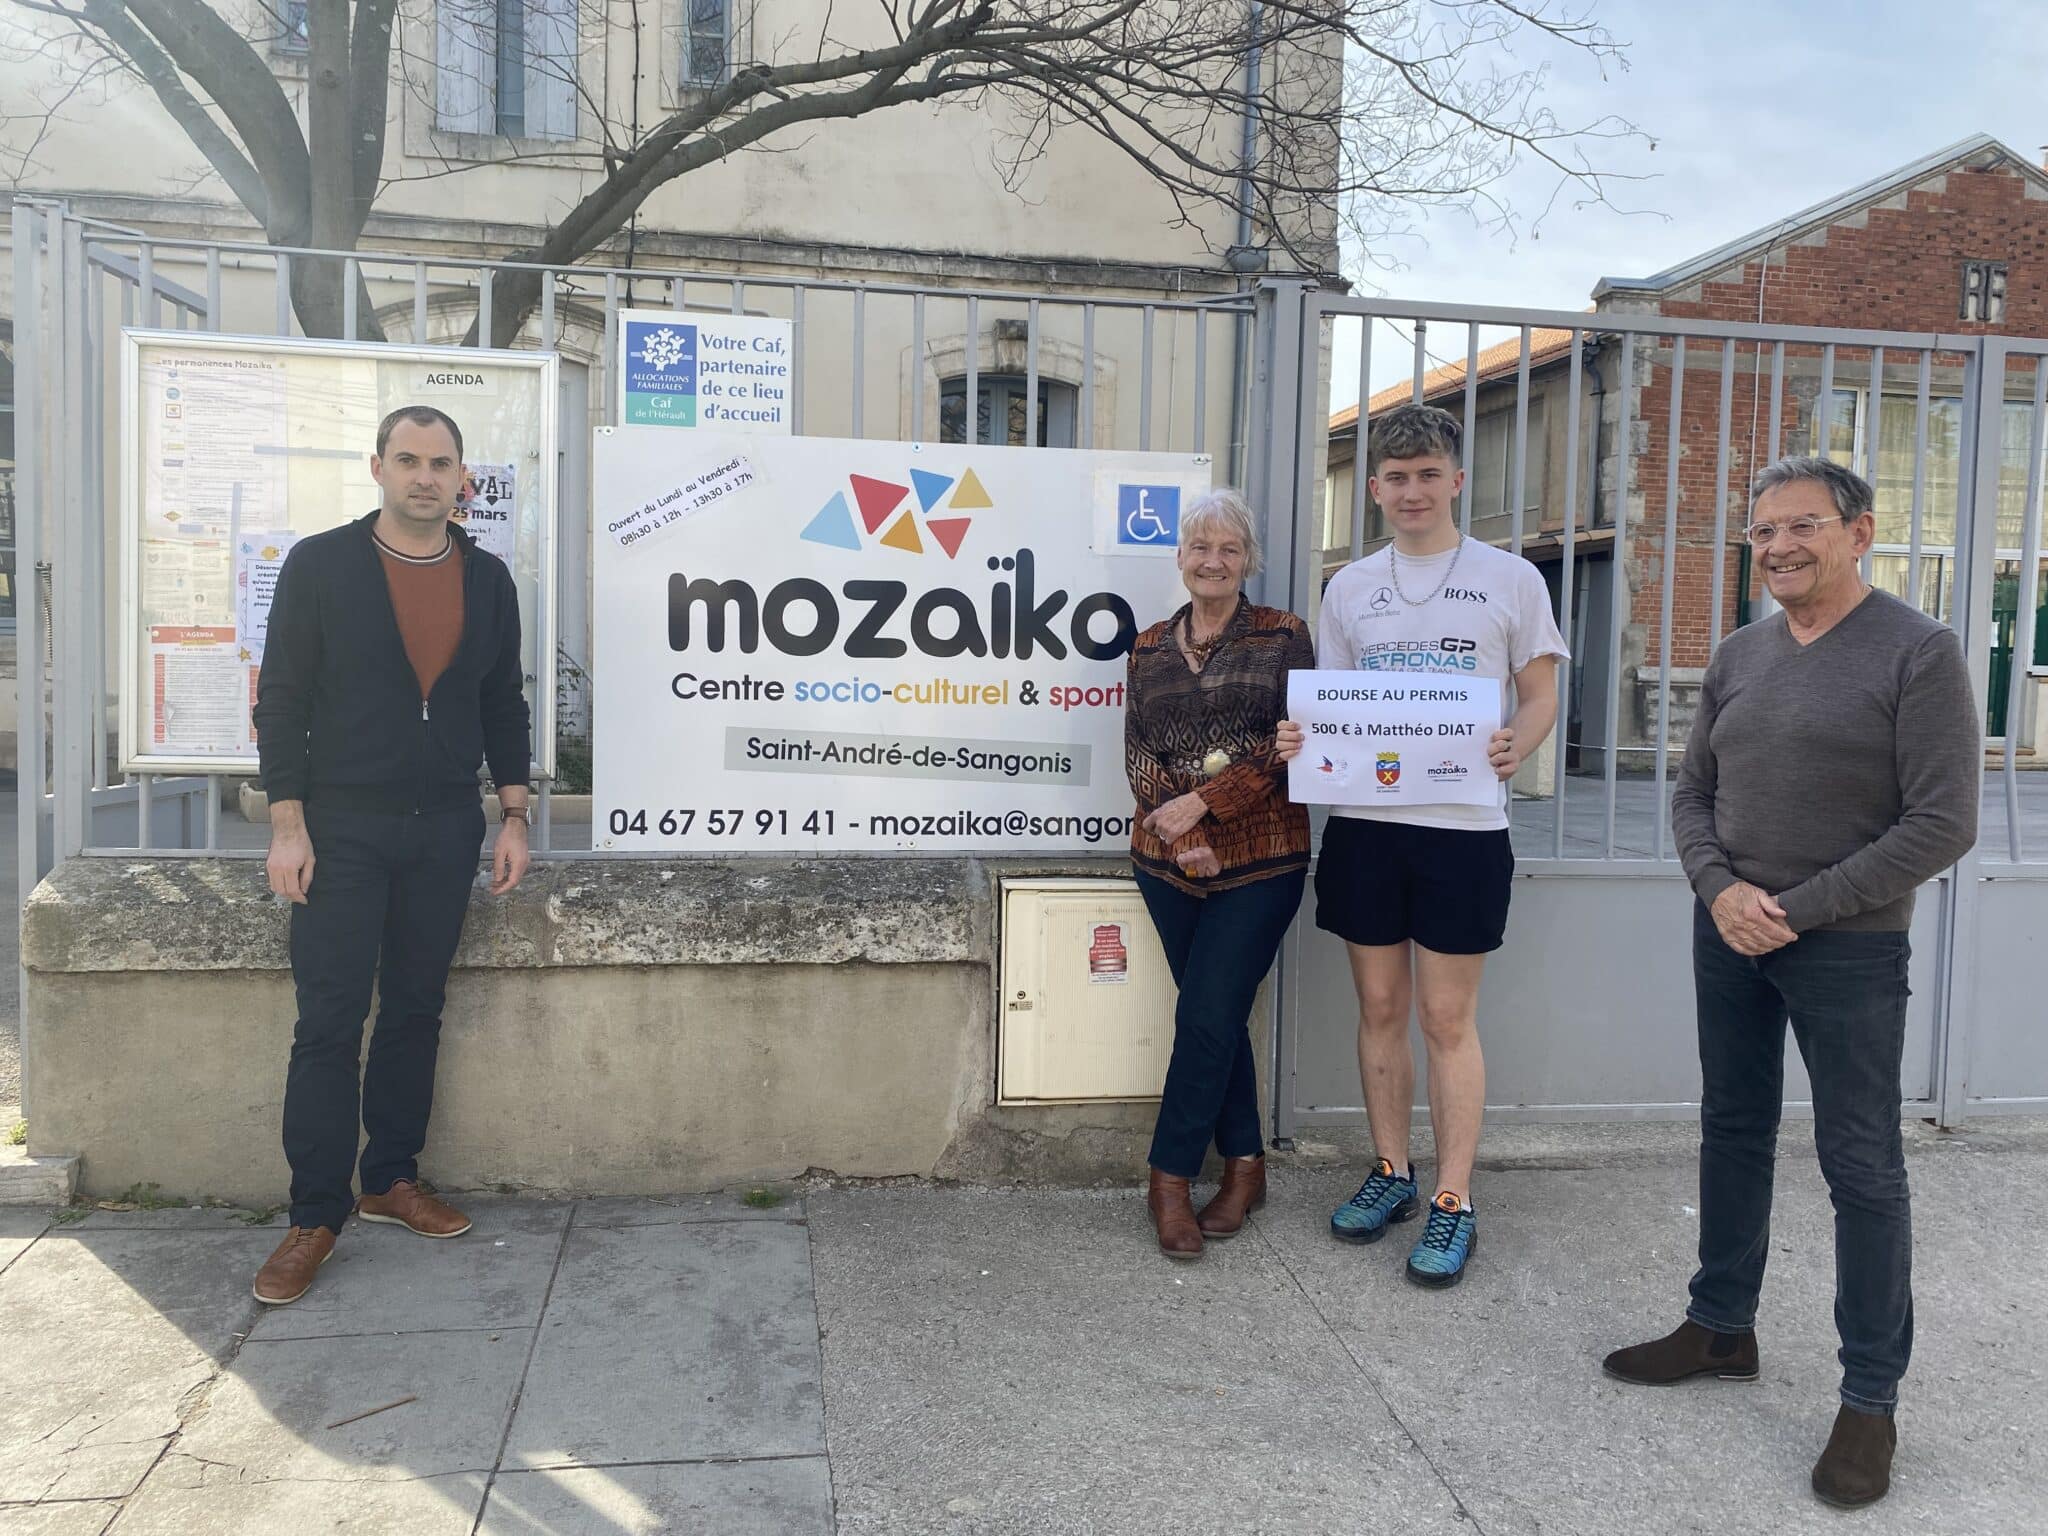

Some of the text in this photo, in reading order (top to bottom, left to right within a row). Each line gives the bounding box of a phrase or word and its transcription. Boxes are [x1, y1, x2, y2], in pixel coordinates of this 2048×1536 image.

[700, 334, 786, 357] Votre Caf,
[700, 360, 787, 377] partenaire
[426, 373, 484, 386] AGENDA
[632, 373, 689, 383] ALLOCATIONS
[637, 381, 683, 391] FAMILIALES
[702, 379, 784, 400] de ce lieu
[650, 397, 672, 409] Caf
[635, 409, 686, 420] de l'Hérault
[704, 403, 781, 423] d'accueil
[608, 511, 641, 533] Ouvert
[644, 504, 656, 515] du
[656, 488, 683, 508] Lundi
[685, 482, 697, 493] au
[698, 458, 740, 485] Vendredi
[452, 507, 508, 521] 25 mars
[620, 524, 651, 546] 08h30
[654, 520, 661, 529] à
[662, 509, 682, 524] 12h
[693, 486, 723, 508] 13h30
[725, 482, 732, 492] à
[734, 472, 753, 487] 17h
[1444, 587, 1488, 604] BOSS
[667, 547, 1139, 662] mozaïka
[671, 672, 785, 702] Centre
[794, 676, 1009, 705] socio-culturel
[1019, 679, 1040, 706] &
[1317, 689, 1468, 702] BOURSE AU PERMIS
[1311, 723, 1475, 737] 500 € à Matthéo DIAT
[746, 736, 1072, 776] Saint-André-de-Sangonis
[609, 809, 648, 835] 04
[658, 809, 696, 835] 67
[707, 809, 744, 835] 57
[755, 809, 787, 835] 91
[802, 809, 834, 835] 41
